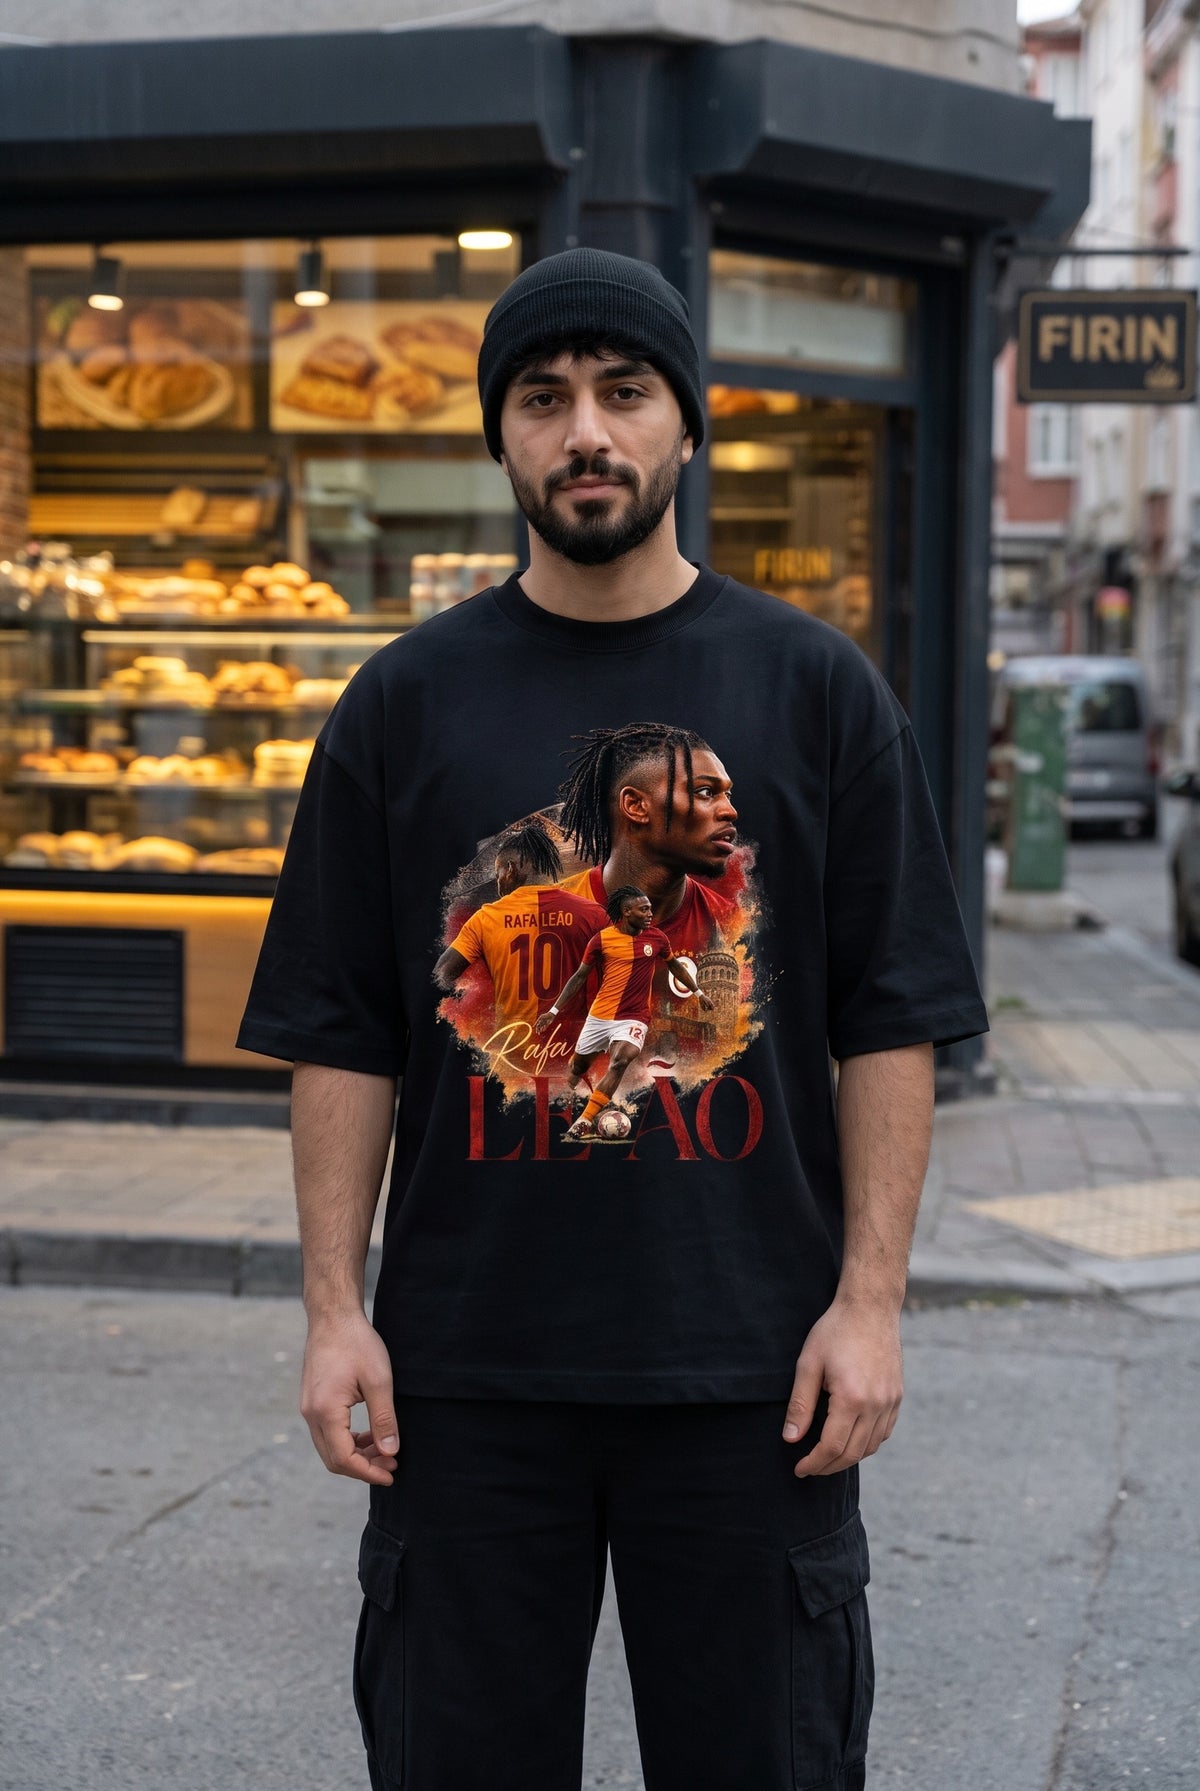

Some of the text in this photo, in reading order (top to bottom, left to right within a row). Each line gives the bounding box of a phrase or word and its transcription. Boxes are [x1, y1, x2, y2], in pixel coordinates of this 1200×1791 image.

[1038, 314, 1178, 364] FIRIN
[504, 910, 573, 929] RAFA LEÃO
[510, 931, 563, 1001] 10
[481, 1020, 572, 1083] Rafa
